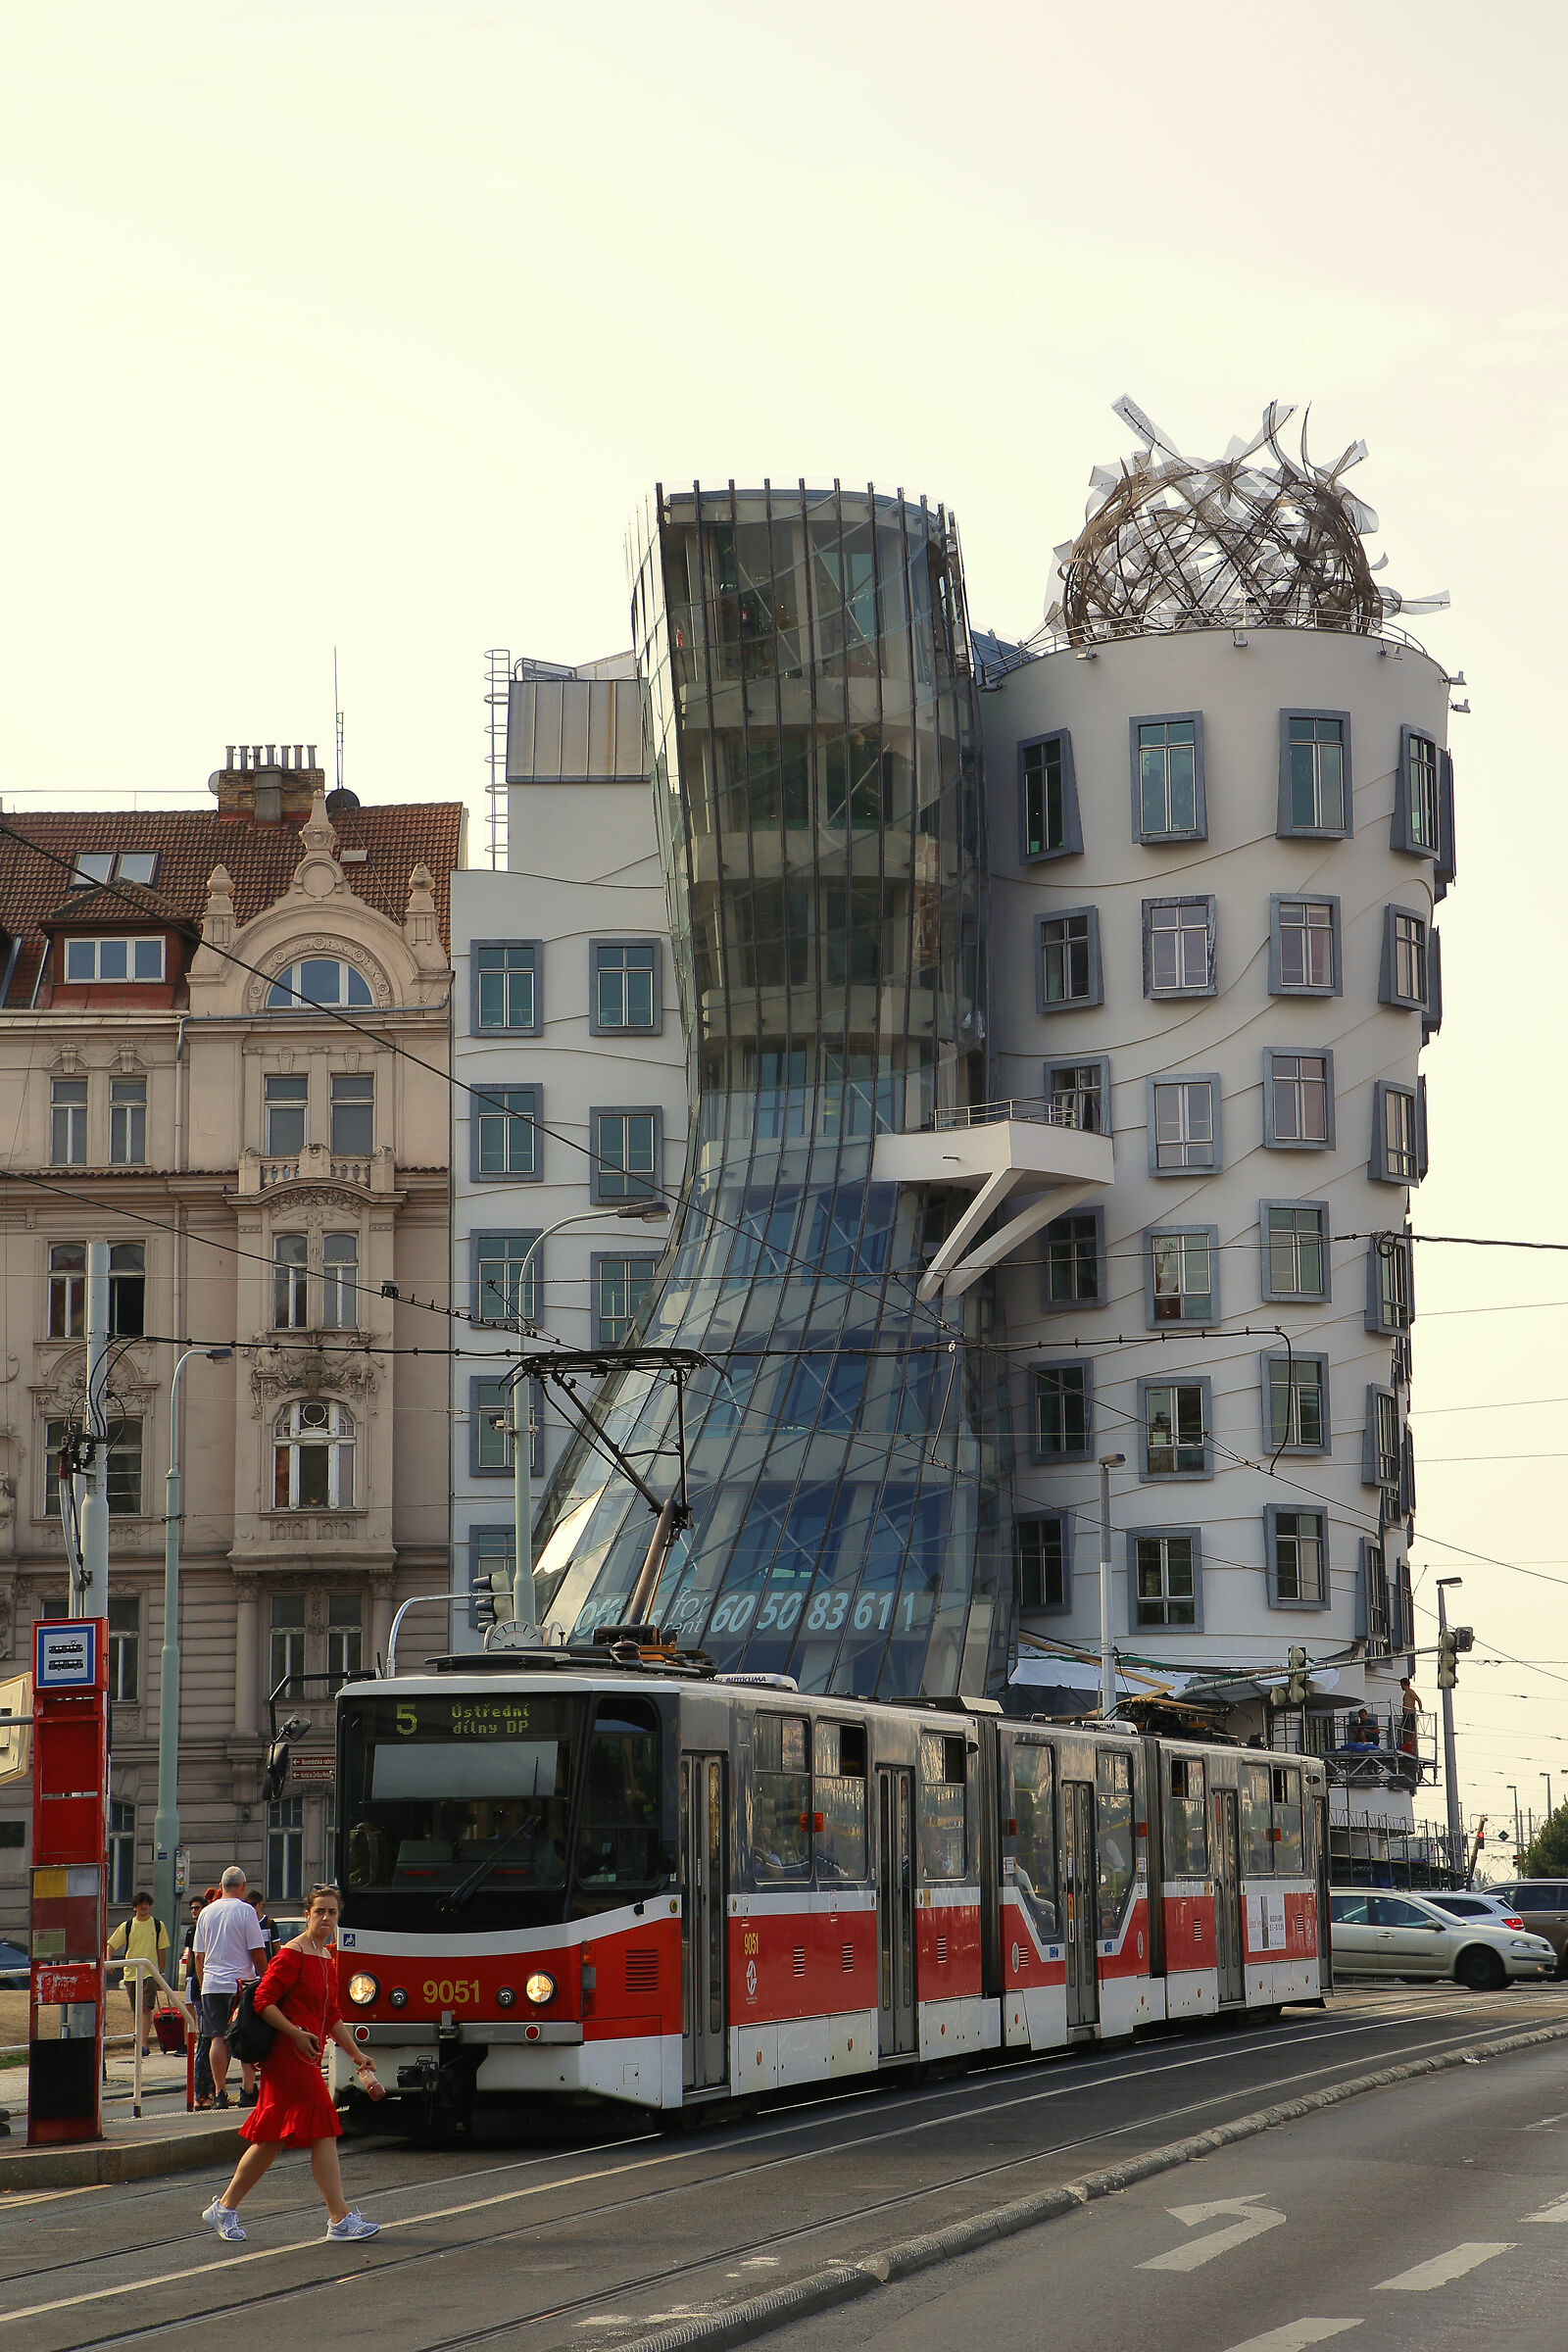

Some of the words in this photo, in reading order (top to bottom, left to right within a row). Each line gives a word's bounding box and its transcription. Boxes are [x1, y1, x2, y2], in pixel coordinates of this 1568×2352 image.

[710, 1594, 757, 1633] 60
[757, 1592, 803, 1631] 50
[808, 1592, 849, 1630] 83
[396, 1703, 417, 1736] 5
[452, 1702, 530, 1718] Ústřední
[453, 1720, 498, 1735] dílny
[506, 1720, 529, 1734] DP
[744, 1933, 760, 1955] 9051
[422, 1980, 480, 2004] 9051
